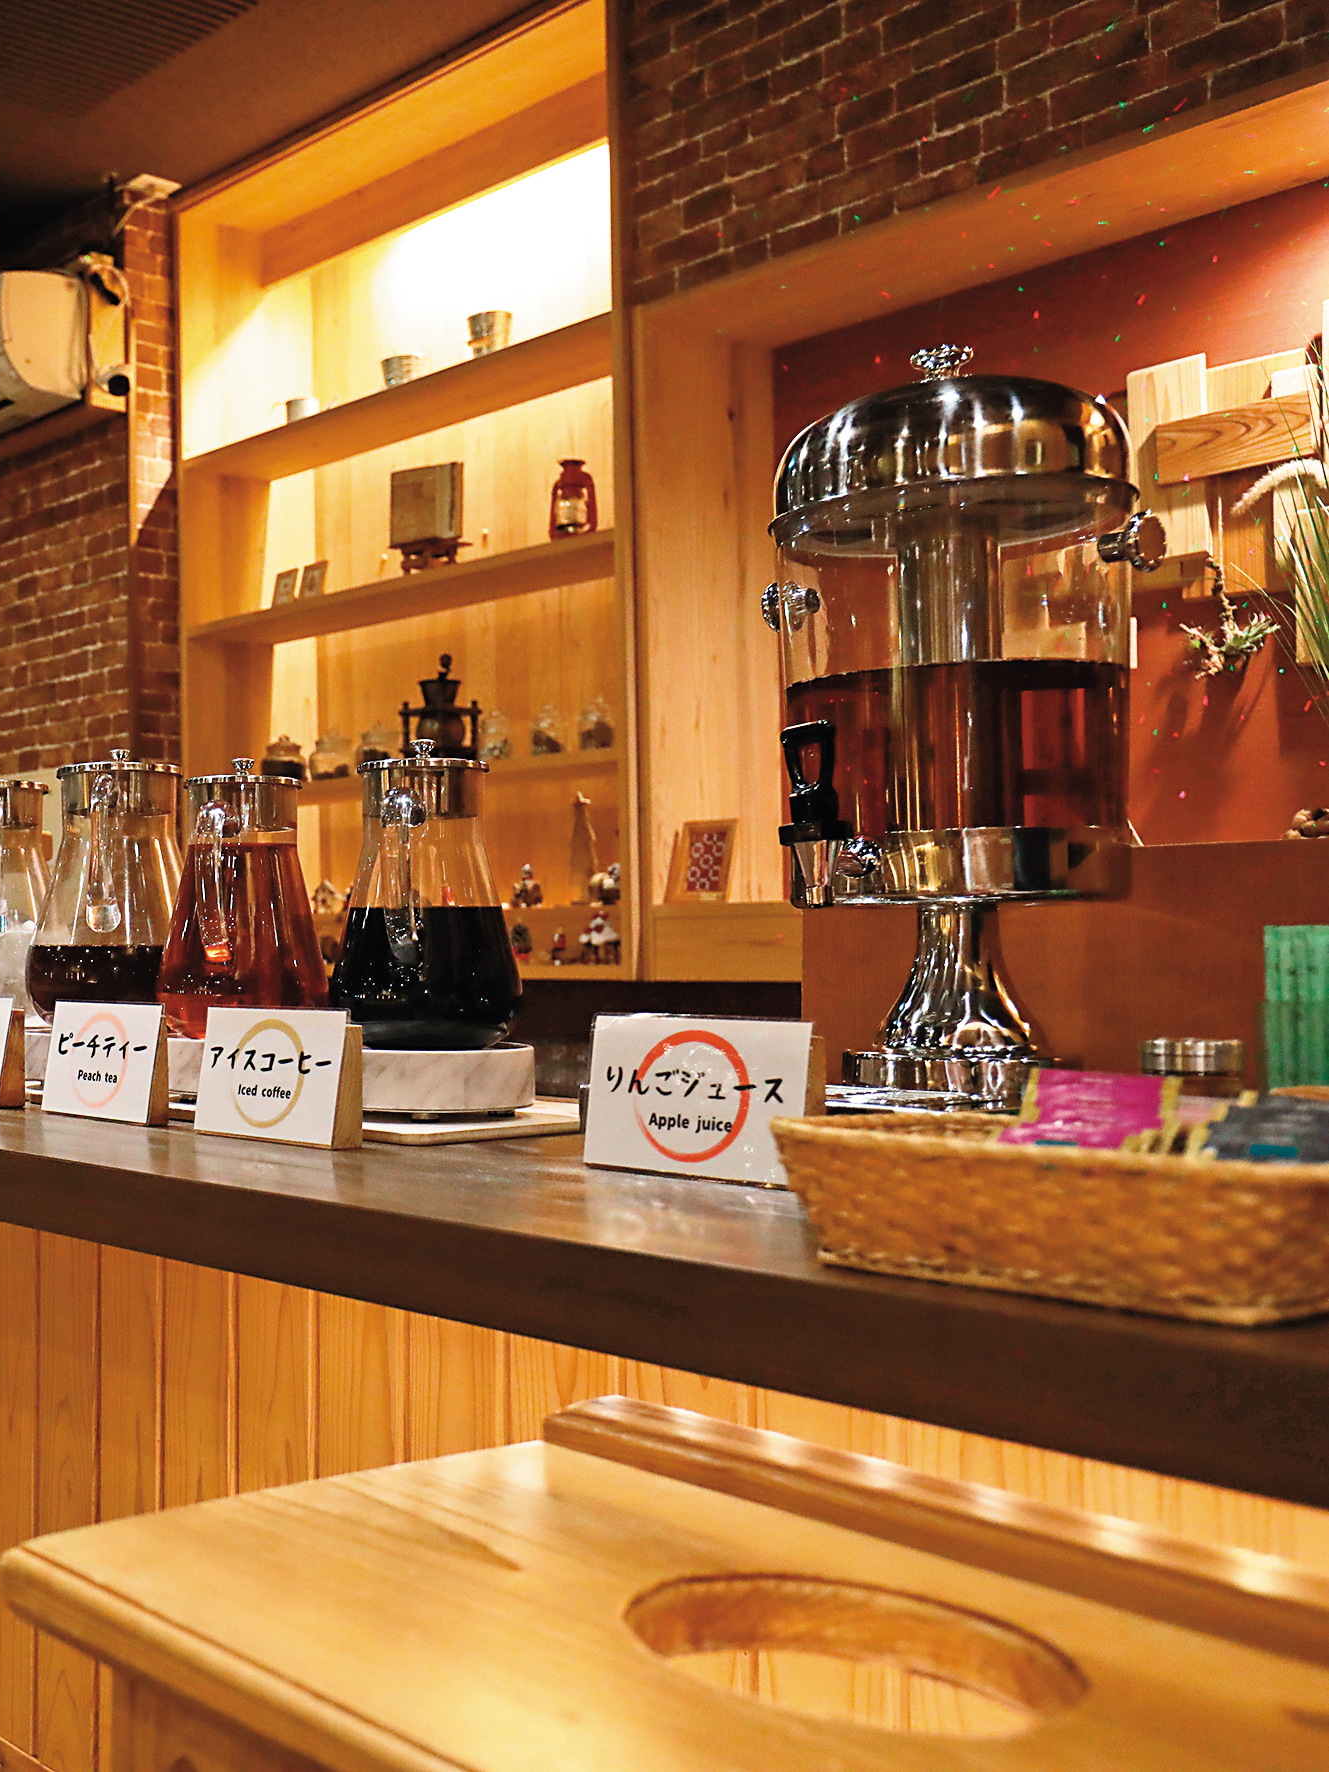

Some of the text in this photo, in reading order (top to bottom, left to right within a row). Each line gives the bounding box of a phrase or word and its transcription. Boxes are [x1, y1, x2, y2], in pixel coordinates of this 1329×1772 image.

[58, 1032, 148, 1060] ピーチティー
[210, 1046, 332, 1075] アイスコーヒー
[77, 1069, 118, 1083] Peach tea
[606, 1065, 784, 1105] りんごジュース
[237, 1083, 292, 1099] Iced coffee
[648, 1111, 733, 1134] Apple juice
